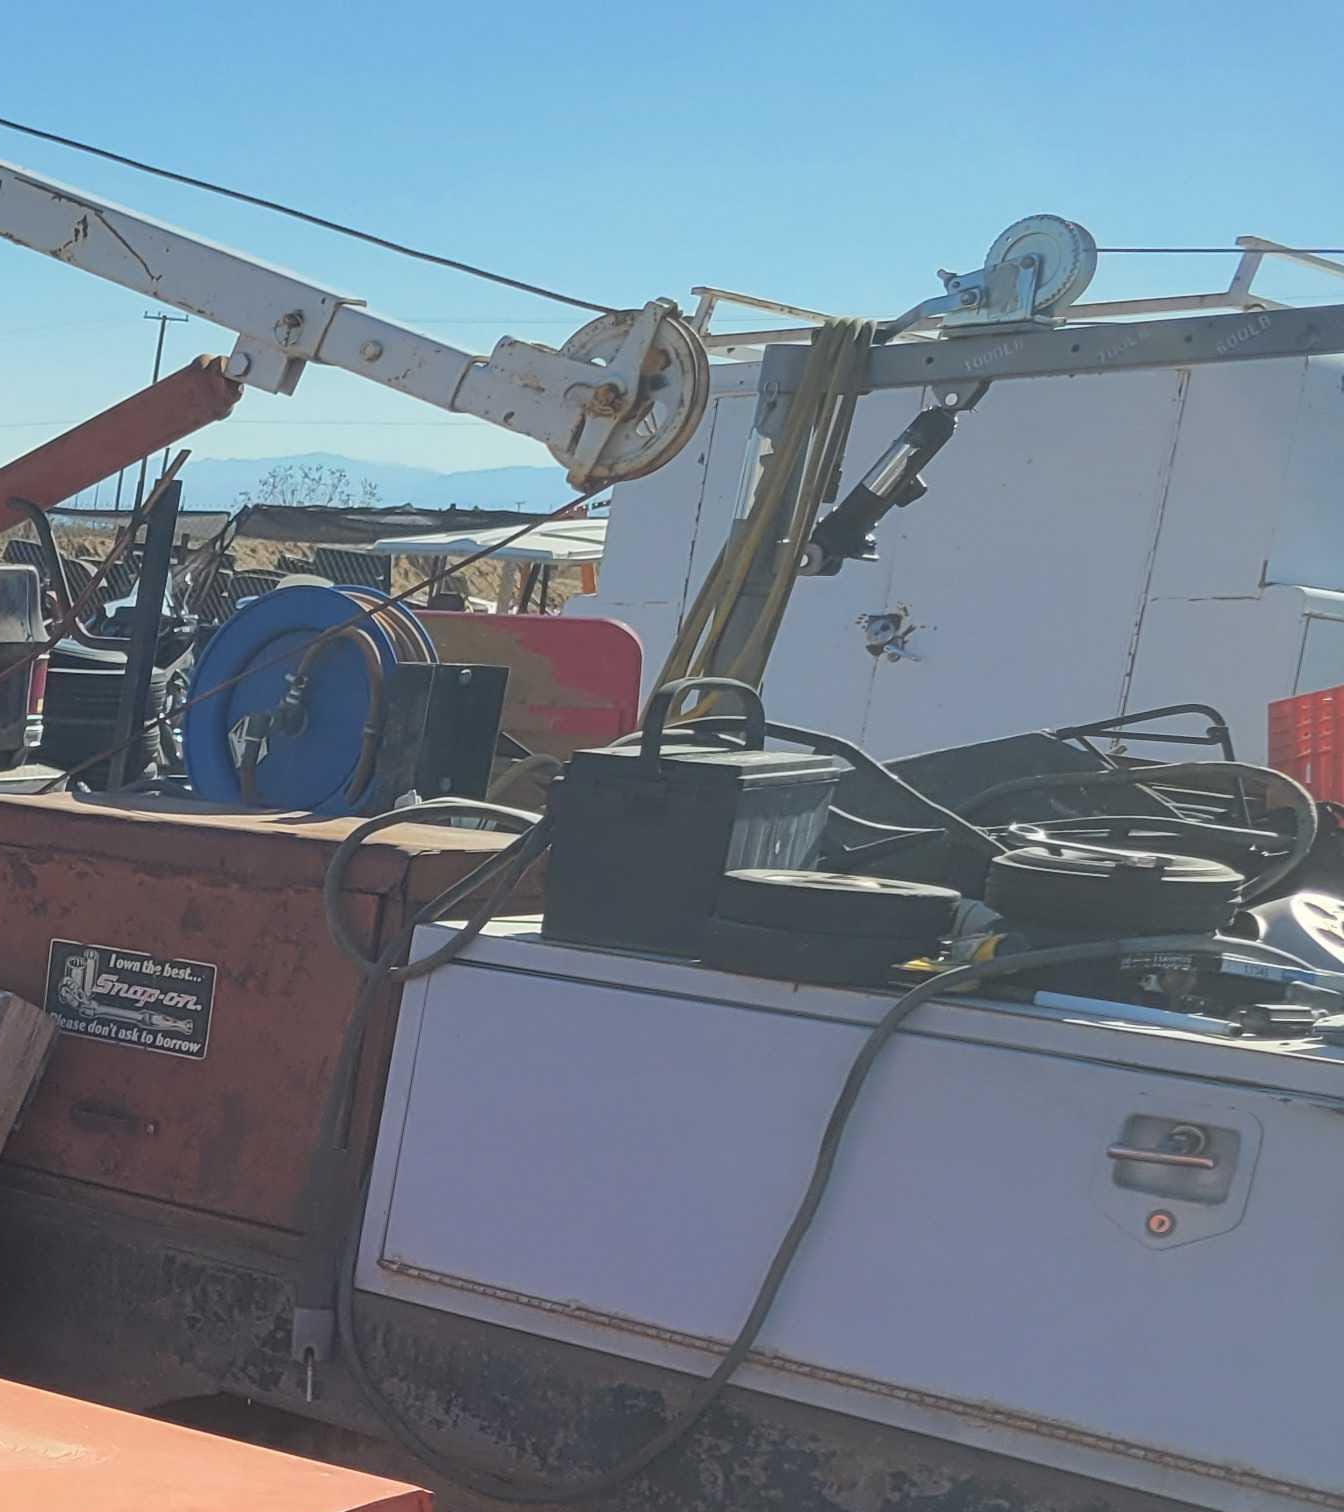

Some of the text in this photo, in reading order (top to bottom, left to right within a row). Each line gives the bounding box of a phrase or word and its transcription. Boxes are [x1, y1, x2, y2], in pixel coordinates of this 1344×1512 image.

[109, 953, 116, 968] I
[116, 959, 141, 972] own
[142, 960, 162, 976] the
[88, 1017, 117, 1036] don't
[118, 1027, 139, 1043] ask
[140, 1030, 154, 1044] to
[155, 1033, 202, 1053] borrow
